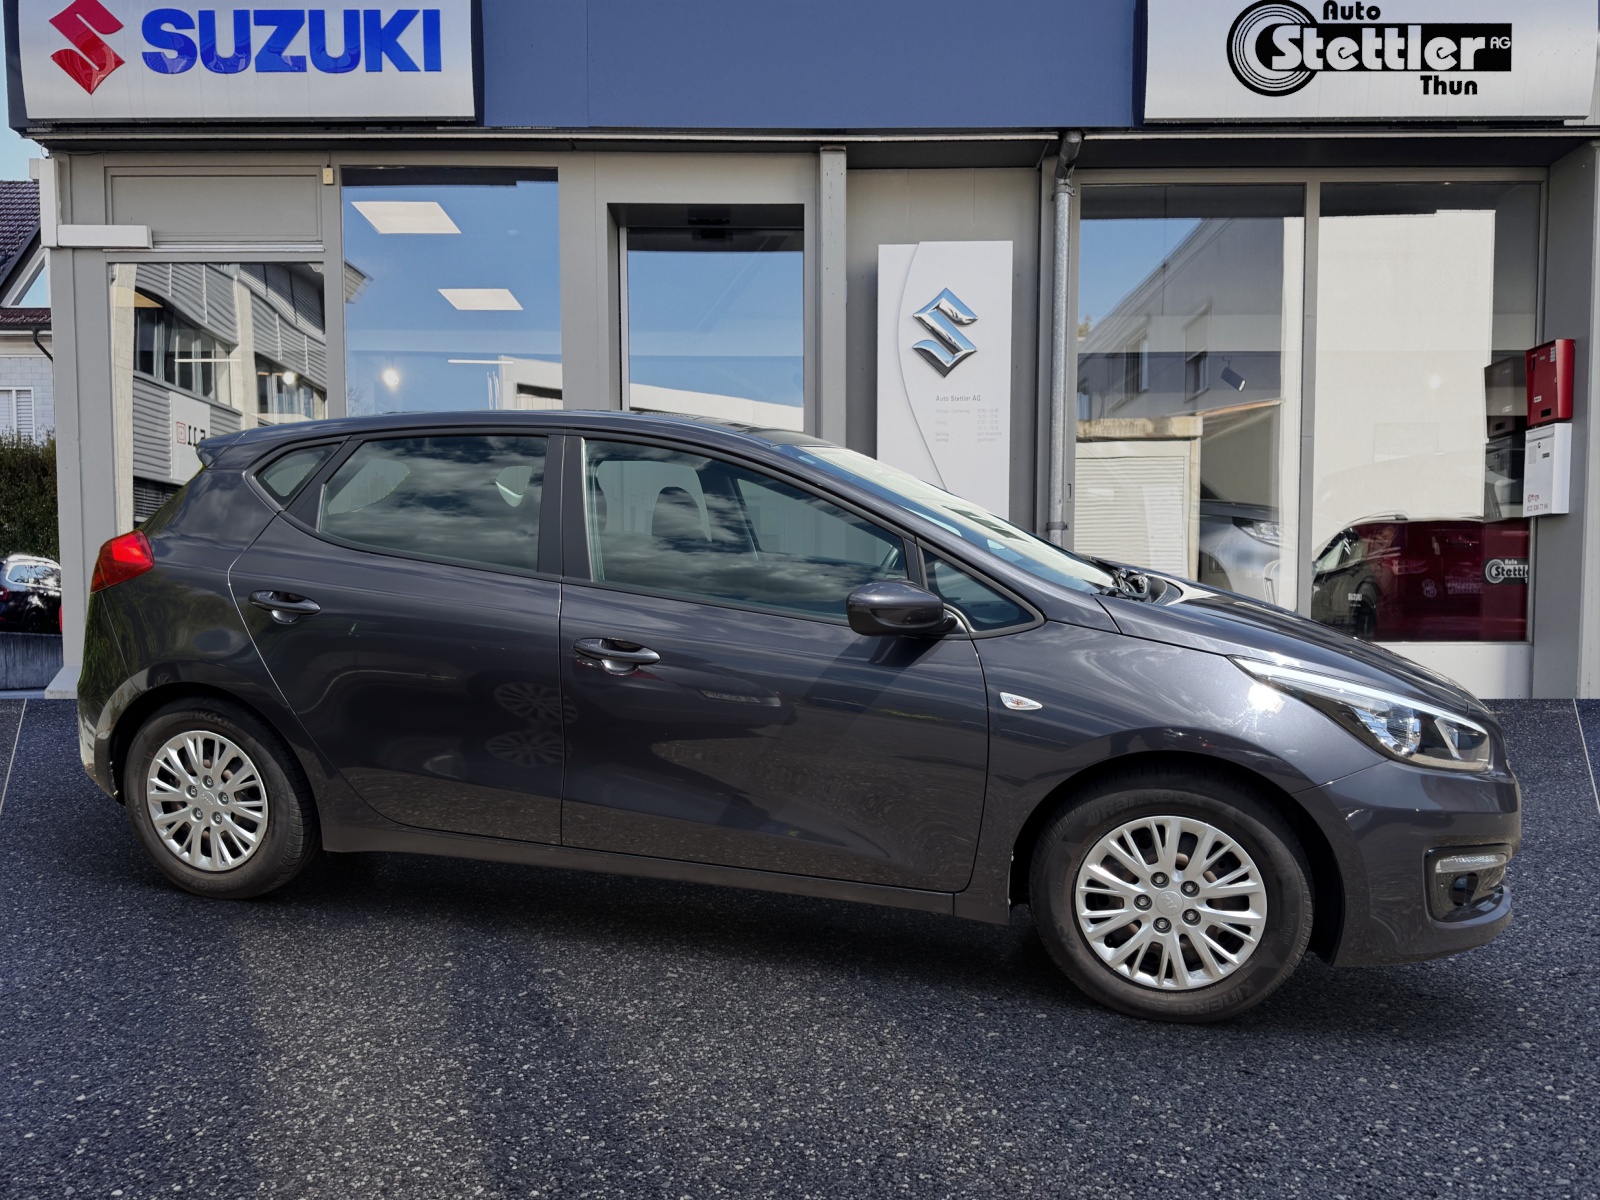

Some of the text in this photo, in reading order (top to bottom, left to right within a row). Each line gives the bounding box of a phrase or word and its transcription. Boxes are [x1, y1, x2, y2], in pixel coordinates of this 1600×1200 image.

[1323, 0, 1381, 21] Auto
[141, 8, 442, 74] SUZUKI
[1271, 25, 1511, 71] Stettler AG
[1420, 75, 1478, 95] Thun
[950, 394, 971, 402] Stettler
[972, 394, 982, 402] AG
